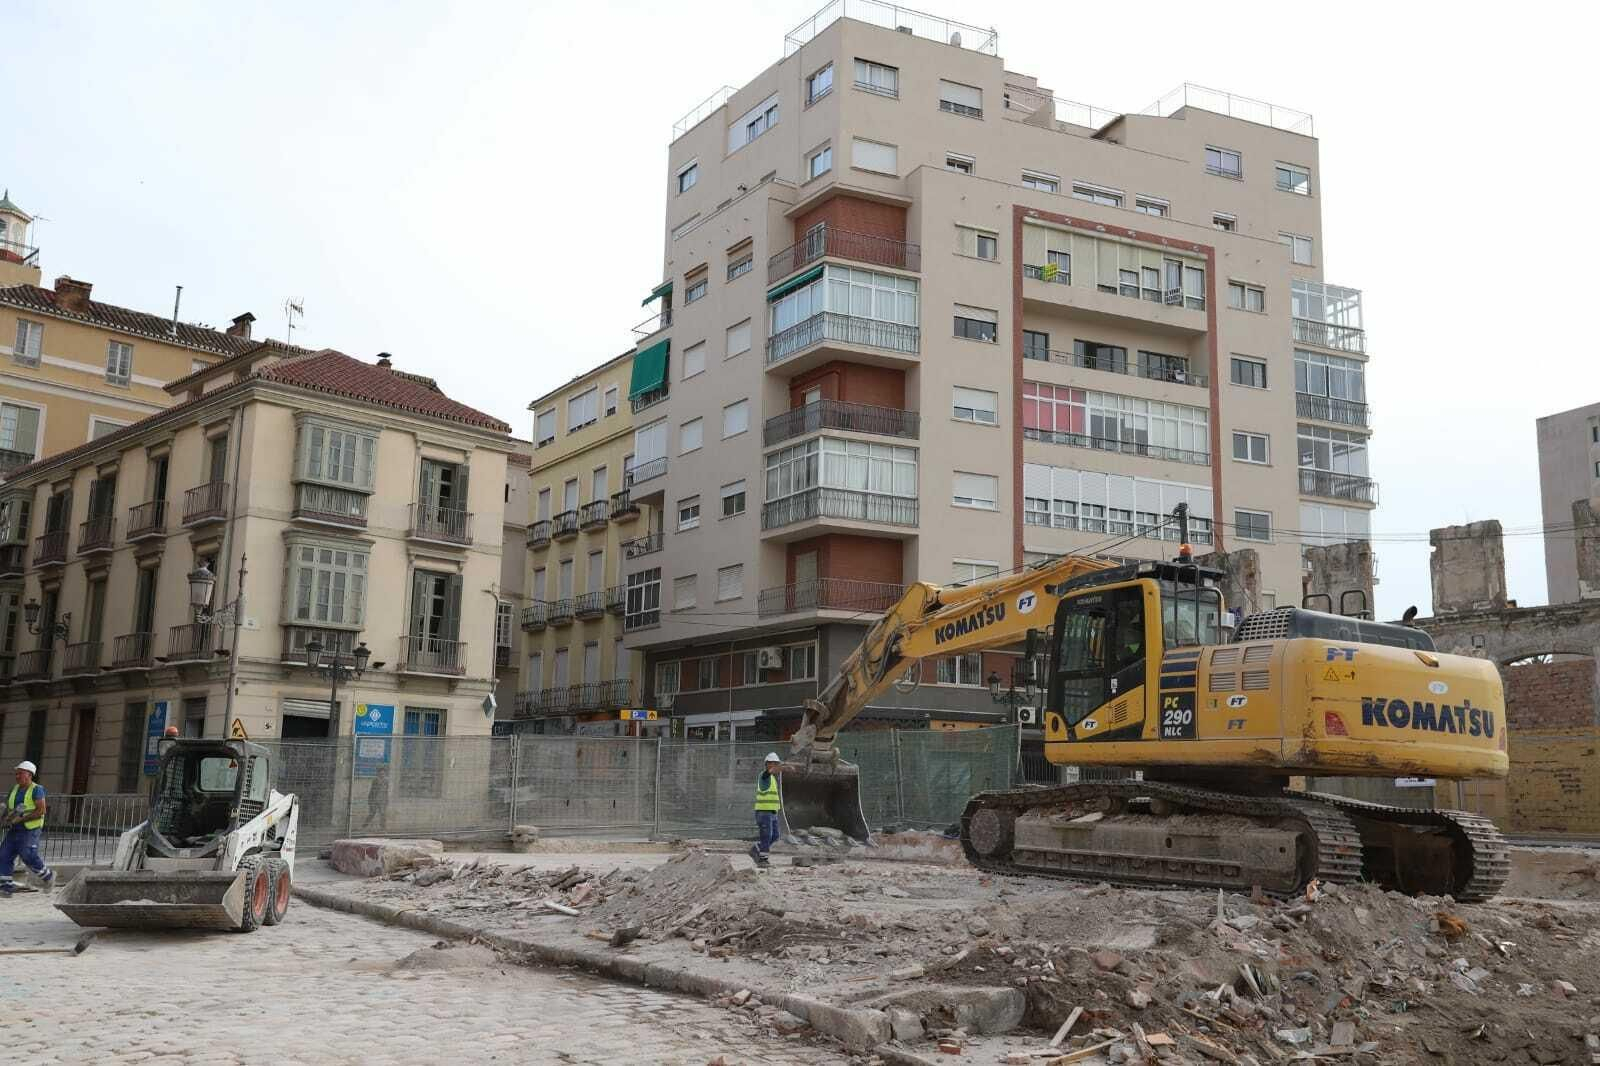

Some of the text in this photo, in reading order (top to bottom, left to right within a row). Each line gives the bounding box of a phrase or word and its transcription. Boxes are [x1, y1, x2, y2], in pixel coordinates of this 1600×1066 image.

[1018, 595, 1036, 610] FT
[934, 601, 1006, 646] KOMATSU
[1326, 647, 1359, 662] FT
[1164, 696, 1179, 709] PC
[1230, 697, 1246, 706] FT
[1163, 709, 1193, 725] 290
[1227, 719, 1248, 730] FT
[1361, 696, 1495, 739] KOMATSU
[1164, 726, 1182, 737] NLC
